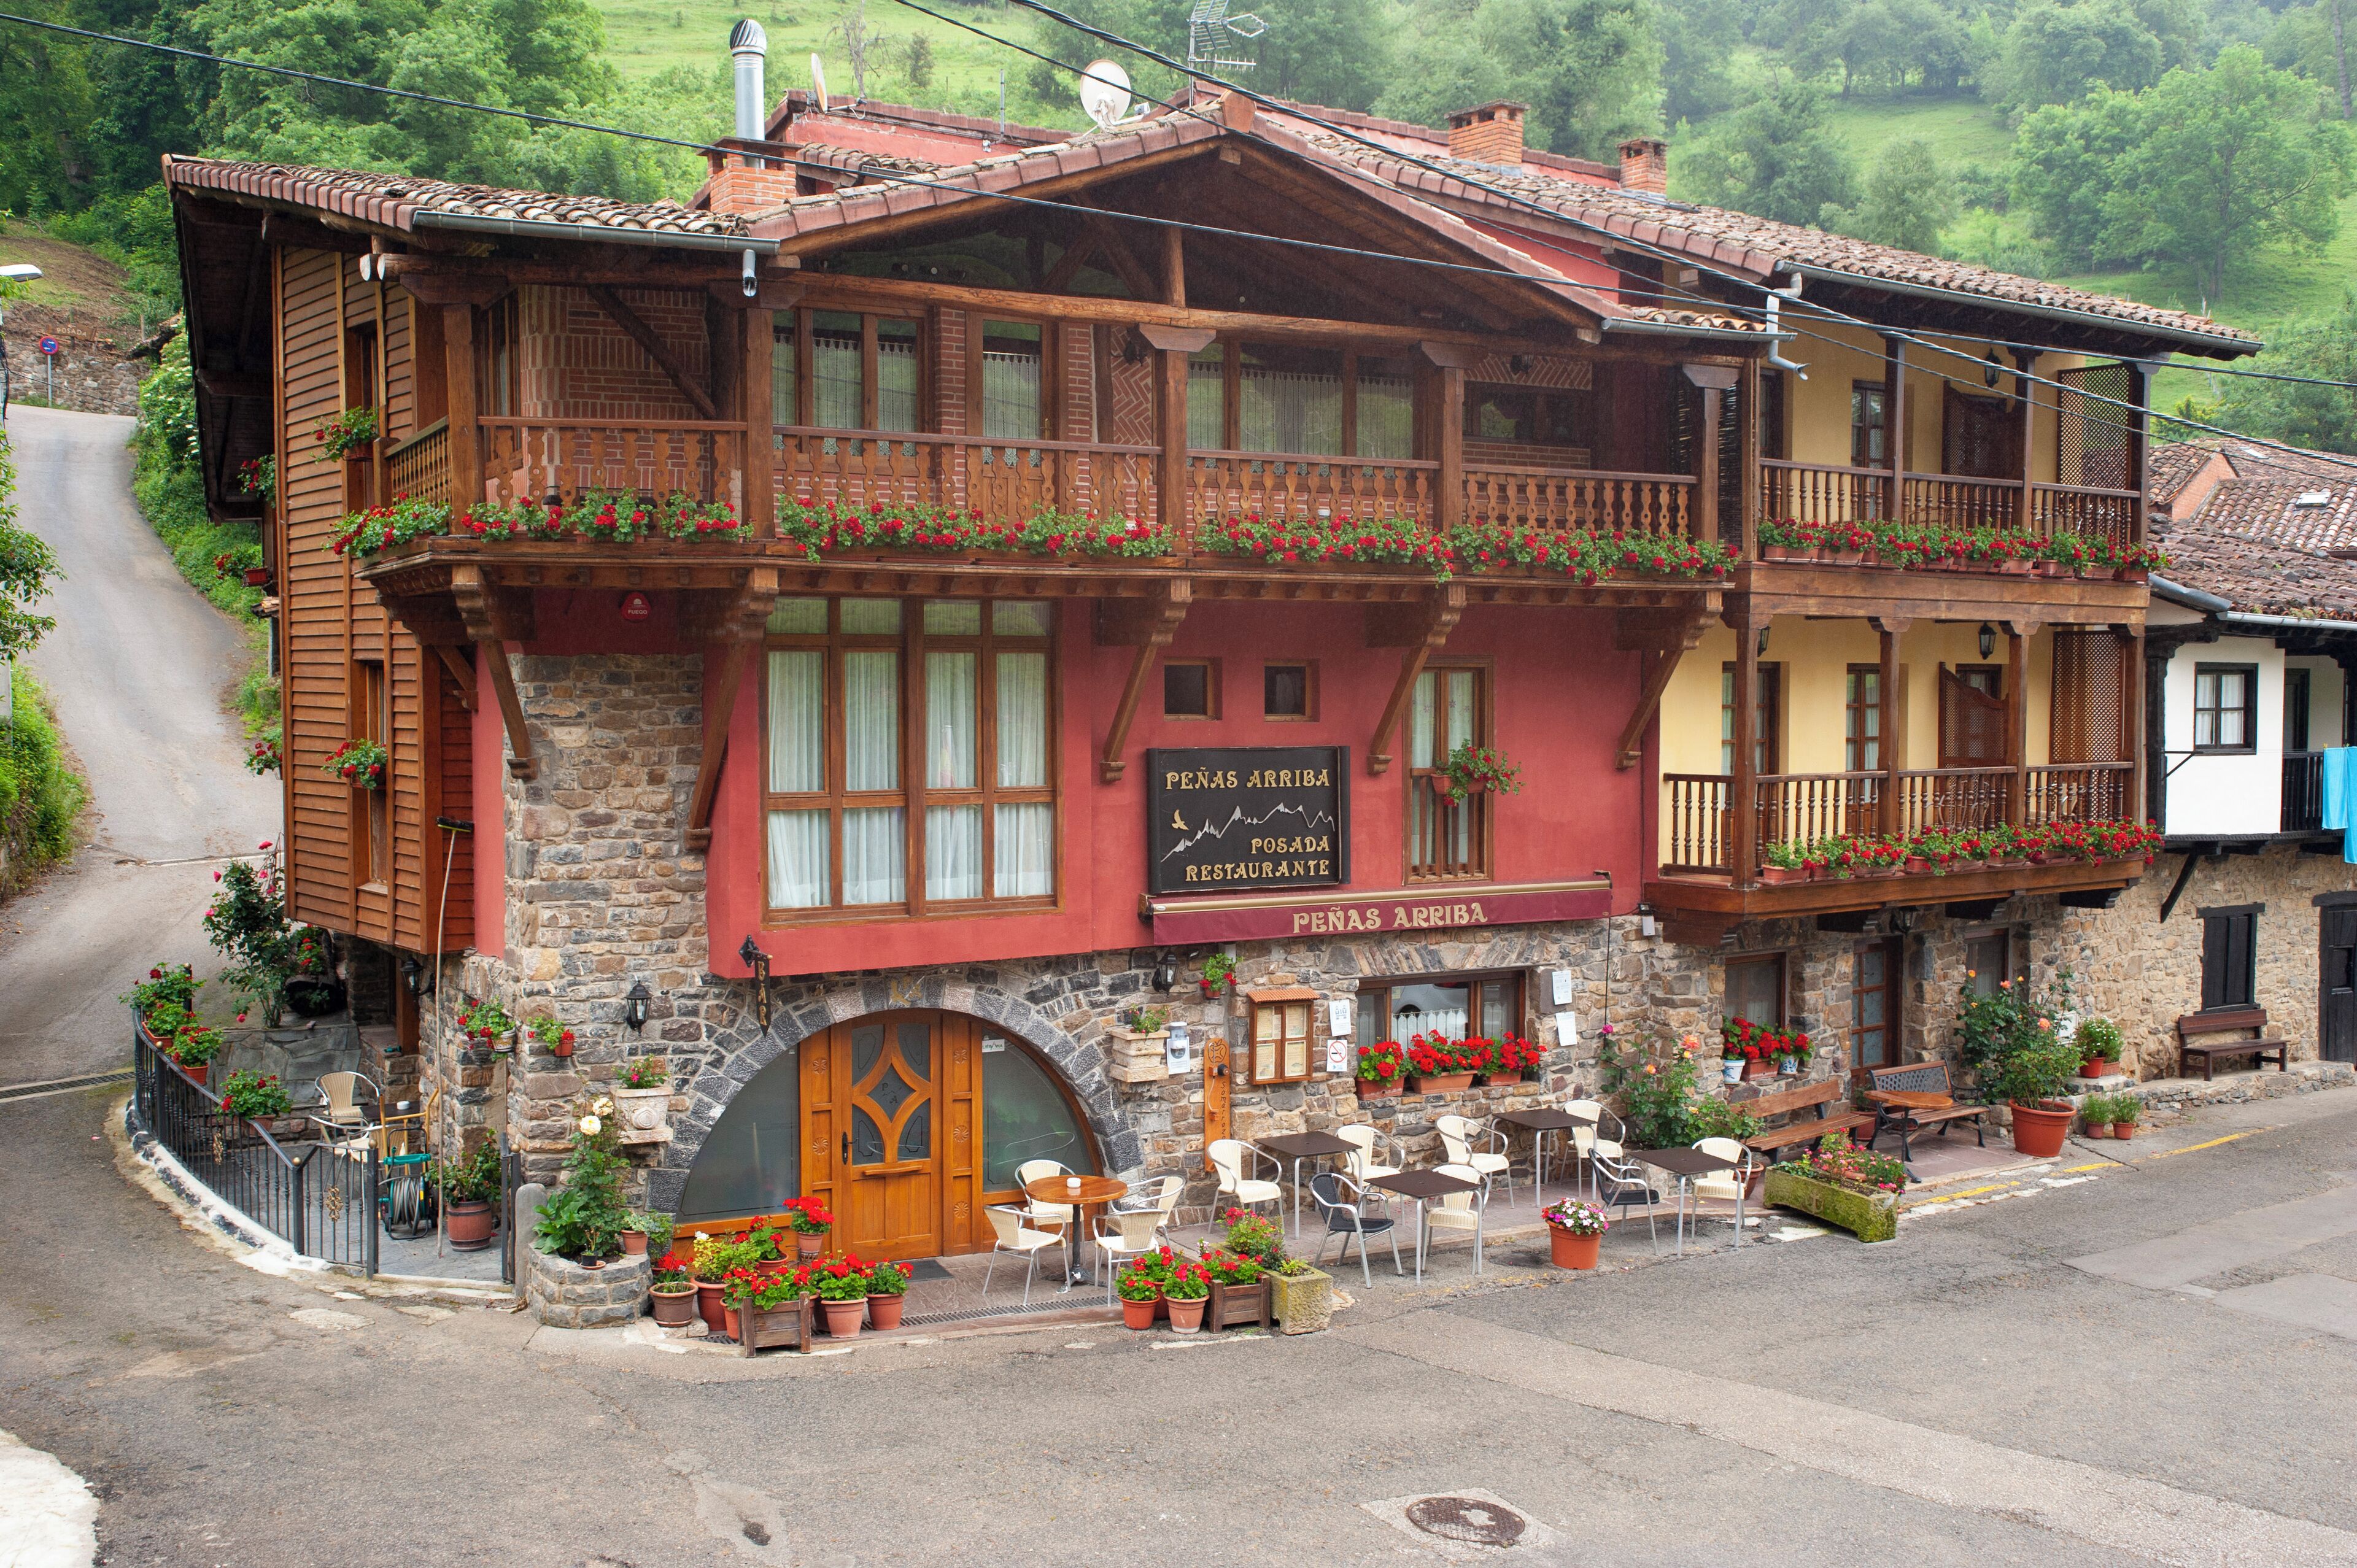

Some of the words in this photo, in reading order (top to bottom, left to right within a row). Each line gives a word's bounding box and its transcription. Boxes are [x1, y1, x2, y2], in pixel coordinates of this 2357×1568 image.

[56, 327, 87, 337] POSADA
[1166, 767, 1238, 790] PEÑAS
[1247, 769, 1330, 788] ARRIBA
[1250, 835, 1329, 854] POSADA
[1185, 859, 1329, 881] RESTAURANTE
[1293, 906, 1381, 933] PEÑAS
[1392, 902, 1488, 928] ARRIBA
[757, 960, 767, 1026] BAR
